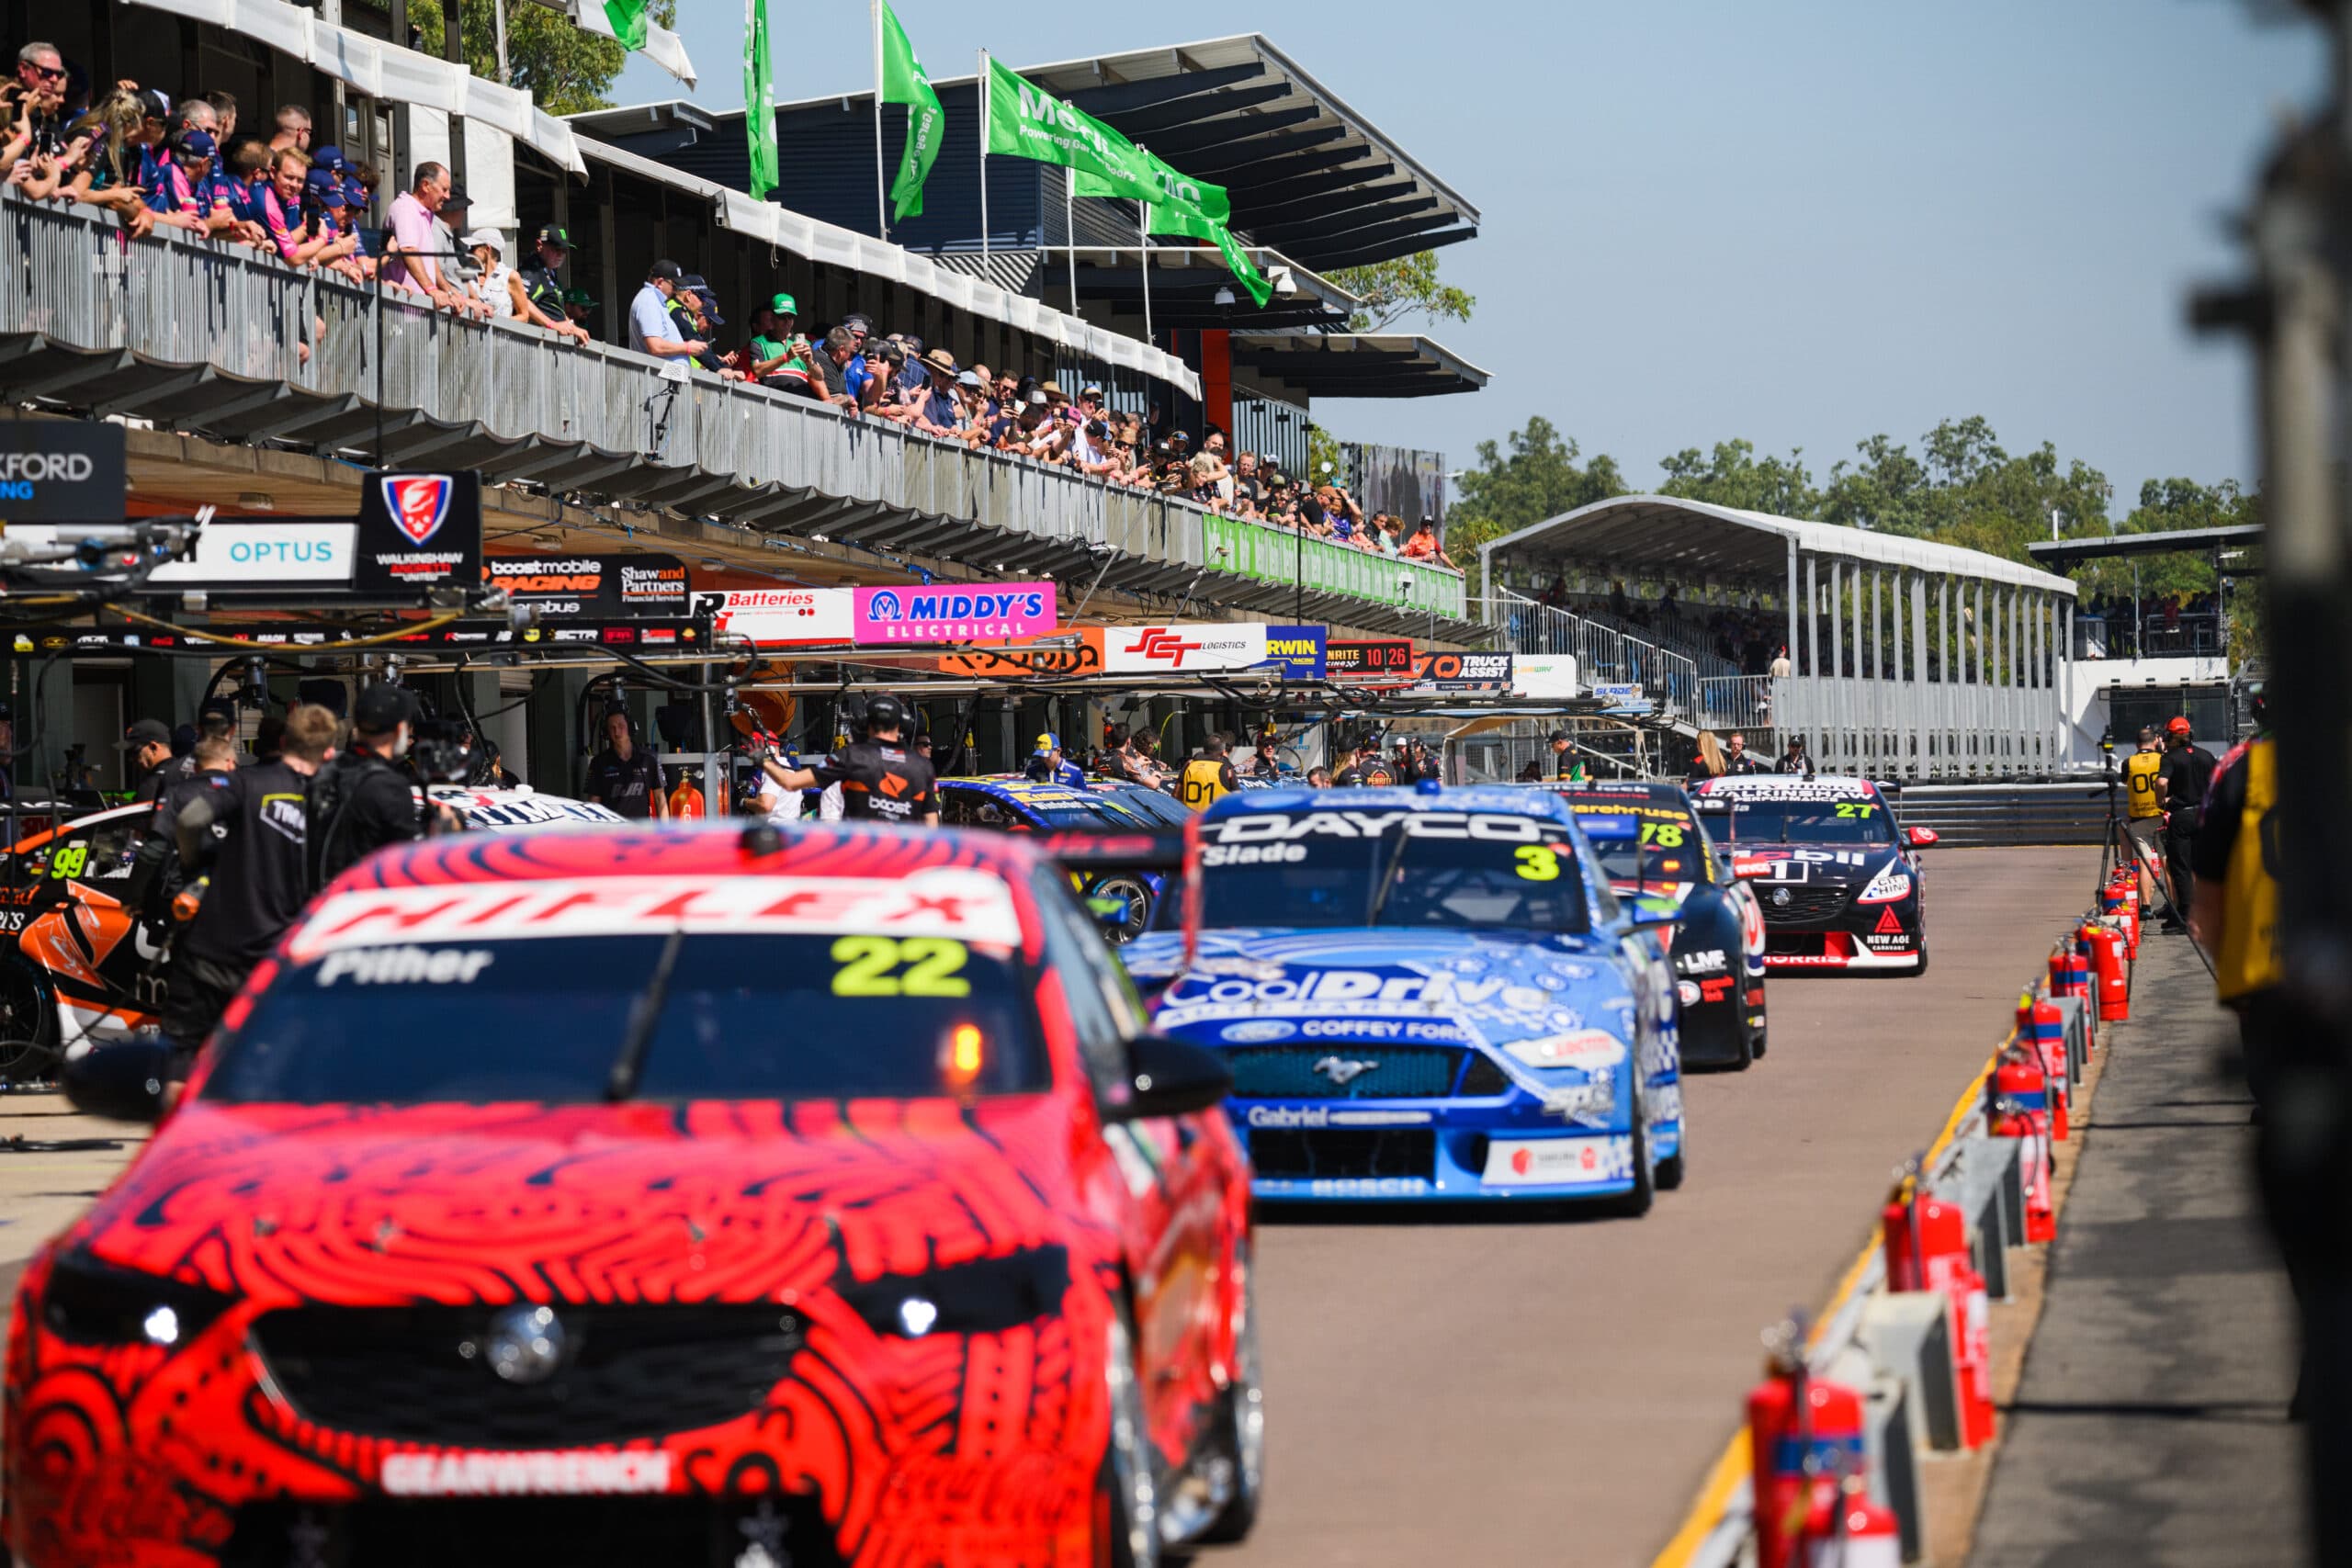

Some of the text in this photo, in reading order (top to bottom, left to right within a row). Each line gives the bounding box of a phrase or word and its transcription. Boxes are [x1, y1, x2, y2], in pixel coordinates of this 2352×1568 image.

[1019, 125, 1071, 149] Powering
[230, 541, 333, 563] OPTUS
[492, 575, 602, 591] RACING
[622, 580, 685, 592] Partners
[728, 591, 814, 606] Batteries
[909, 593, 1045, 620] MIDDY'S
[887, 623, 1026, 638] ELECTRICAL
[1203, 641, 1247, 650] LOGISTICS
[1366, 649, 1382, 666] 10
[1388, 648, 1407, 665] 26
[1461, 655, 1510, 668] TRUCK
[1457, 666, 1509, 679] ASSIST
[868, 795, 912, 816] boost
[1700, 790, 1874, 801] WALKINSHAW
[1835, 803, 1872, 818] 27
[1216, 811, 1542, 844] DAYCO
[1641, 822, 1684, 847] 78
[51, 847, 88, 879] 99
[1201, 841, 1307, 866] Slade
[1514, 845, 1560, 881] 3
[1866, 934, 1890, 944] NEW
[314, 945, 495, 988] Pither
[830, 934, 972, 997] 22
[1302, 1020, 1472, 1042] COFFEY FORD
[1248, 1105, 1329, 1127] Gabriel
[379, 1448, 673, 1497] GEARWRENCH
